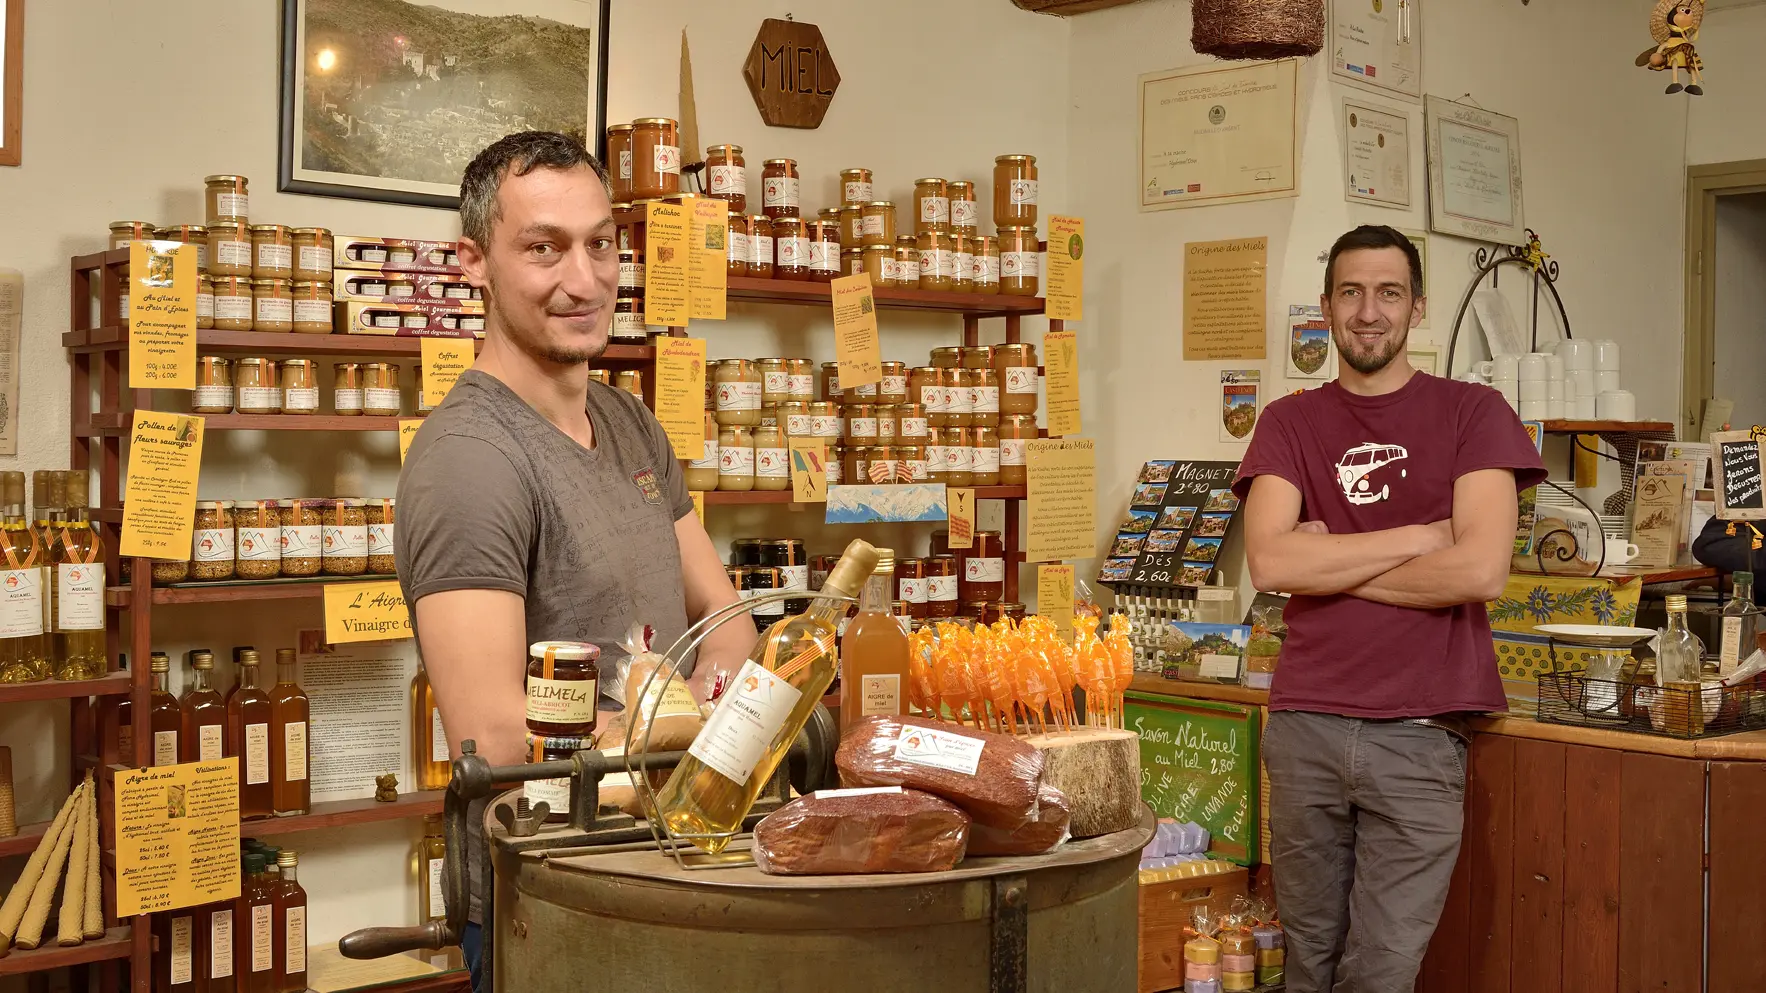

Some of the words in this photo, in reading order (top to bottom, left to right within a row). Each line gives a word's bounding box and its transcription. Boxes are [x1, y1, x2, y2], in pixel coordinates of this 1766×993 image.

[652, 207, 681, 217] Melichoc
[397, 239, 416, 247] Miel
[1190, 246, 1225, 256] Origine
[1226, 243, 1241, 252] des
[1242, 241, 1265, 251] Miels
[619, 266, 645, 274] MELICH
[143, 294, 156, 302] Au
[157, 293, 174, 303] Miel
[145, 303, 162, 311] Pain
[617, 315, 645, 324] MELICH
[165, 330, 189, 340] fromages
[670, 340, 684, 348] Miel
[147, 347, 176, 356] vinaigrette
[438, 352, 459, 360] Coffret
[145, 363, 158, 371] 100g
[432, 363, 464, 371] dégustation
[145, 371, 158, 380] 200g
[137, 420, 165, 431] Pollen
[167, 422, 176, 431] de
[134, 434, 158, 444] fleurs
[160, 438, 193, 450] sauvages
[1027, 441, 1058, 453] Origine
[1060, 441, 1073, 450] des
[1074, 440, 1094, 450] Miels
[1723, 444, 1759, 455] Demandez
[1724, 456, 1744, 467] Nous
[1175, 462, 1238, 481] MAGNET
[806, 490, 812, 498] N
[1727, 497, 1739, 507] Nos
[959, 505, 964, 513] S
[1141, 554, 1173, 567] Dés
[341, 618, 399, 634] Vinaigre
[733, 699, 762, 720] AQUAMEL
[1134, 716, 1172, 745] Savon
[1174, 720, 1241, 757] Naturel
[1154, 754, 1171, 765] au
[1174, 749, 1203, 769] Miel
[1210, 756, 1237, 776] 2,80€
[126, 775, 149, 785] Aigre
[160, 771, 176, 779] miel
[1140, 768, 1151, 786] is
[1201, 775, 1238, 822] LAVANDE
